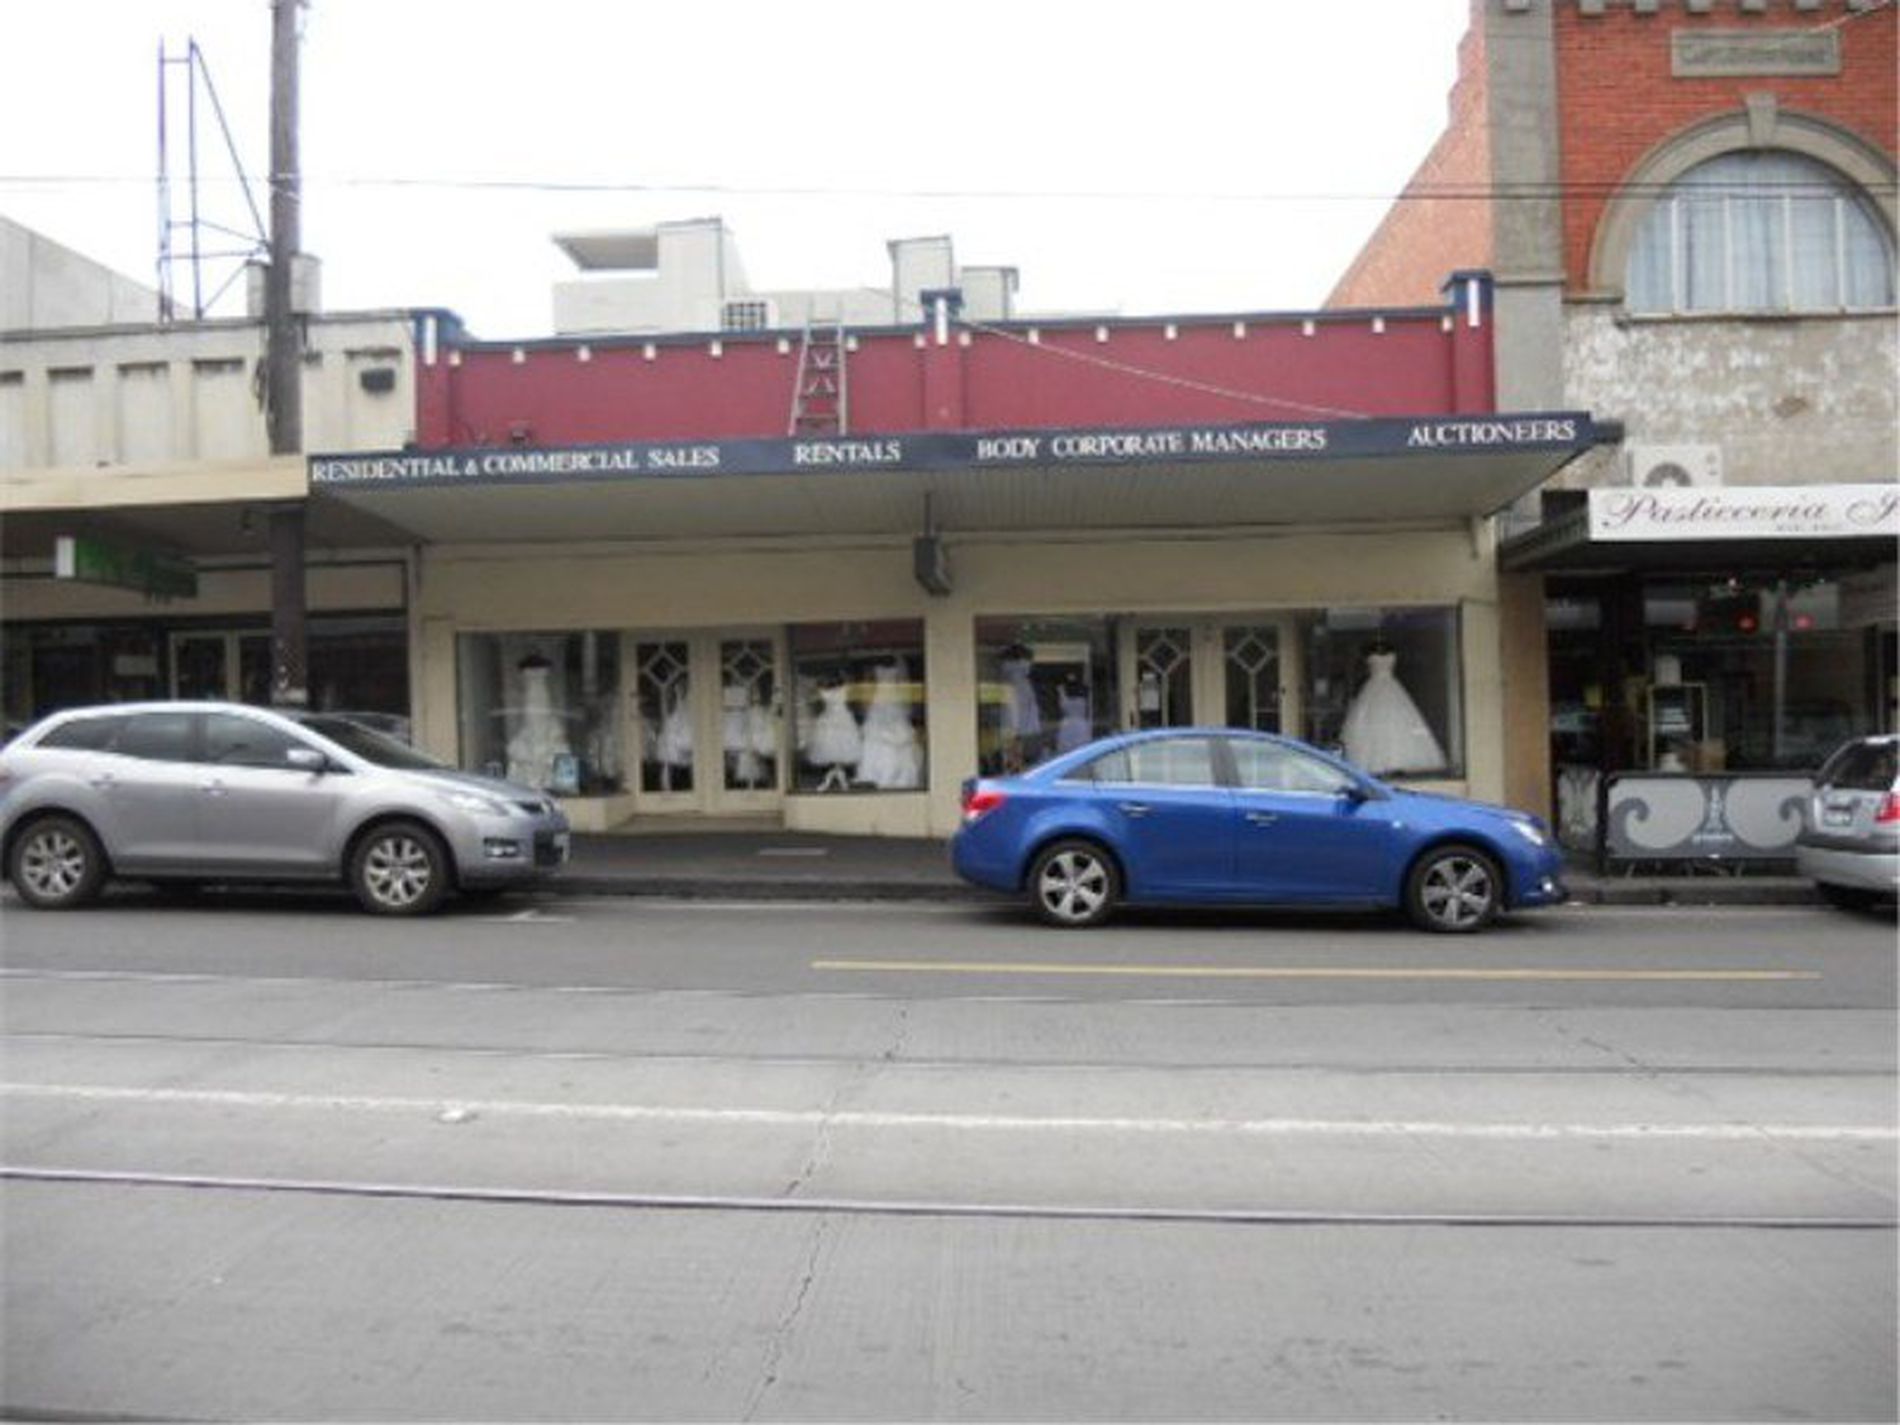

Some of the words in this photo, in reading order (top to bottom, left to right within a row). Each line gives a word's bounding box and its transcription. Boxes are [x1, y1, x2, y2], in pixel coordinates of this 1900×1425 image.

[976, 438, 1042, 460] BODY
[1052, 432, 1184, 457] CORPORATE
[1191, 428, 1326, 453] MANAGERS
[1407, 419, 1576, 447] AUCTIONEERS
[312, 455, 459, 482] RESIDENTIAL
[464, 459, 478, 476] &
[483, 450, 639, 475] COMMERCIAL
[647, 446, 720, 468] SALES
[794, 440, 902, 464] RENTALS
